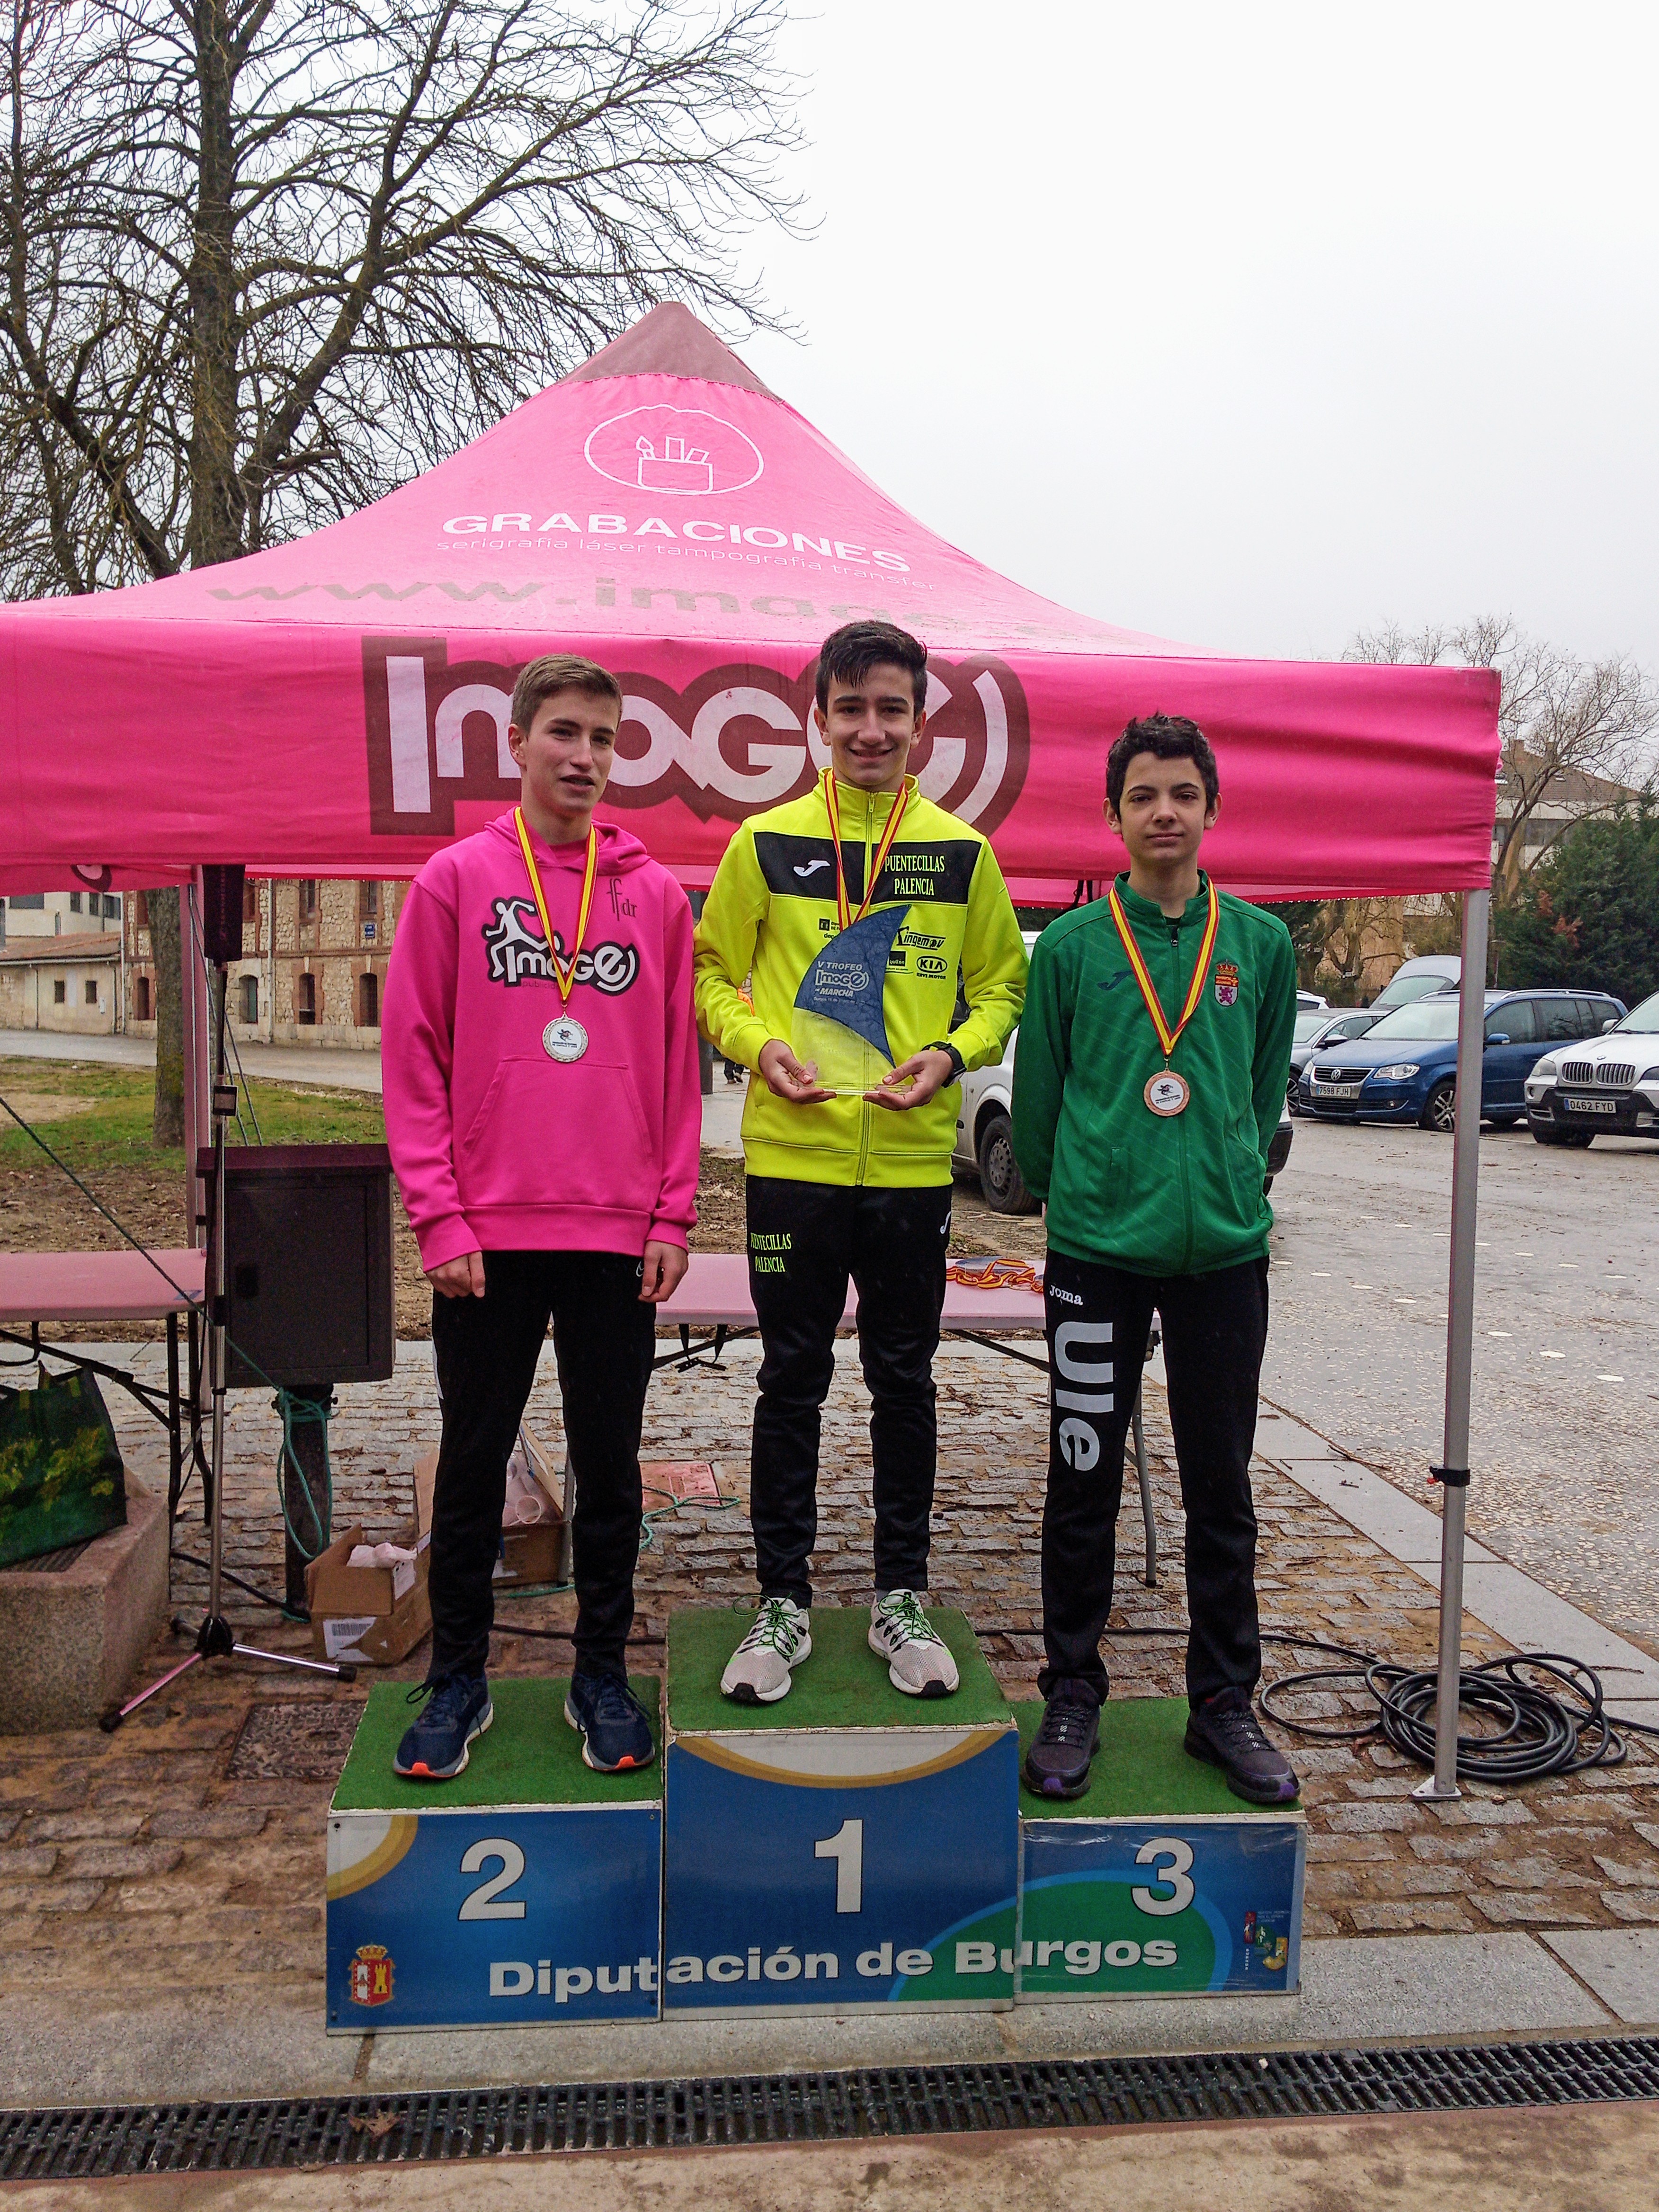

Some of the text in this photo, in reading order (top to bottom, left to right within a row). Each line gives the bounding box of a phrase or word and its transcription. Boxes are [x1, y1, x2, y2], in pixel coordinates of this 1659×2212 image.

[443, 512, 910, 572] GRABACIONES
[437, 538, 937, 591] serigrafía láser tampografía transfer
[884, 855, 945, 873] PUENTECILLAS
[894, 878, 935, 896] PALENCIA
[826, 962, 863, 971] TROFEO
[920, 959, 943, 970] KIA
[820, 987, 854, 997] MARCHA
[1336, 1087, 1349, 1096] FJH
[1570, 1100, 1614, 1112] 0462 FYD
[755, 1256, 785, 1272] PALENCIA
[814, 1819, 864, 1913] 1
[458, 1837, 526, 1921] 2
[1131, 1837, 1195, 1916] 3
[489, 1940, 1177, 2004] Diputación de Burgos
